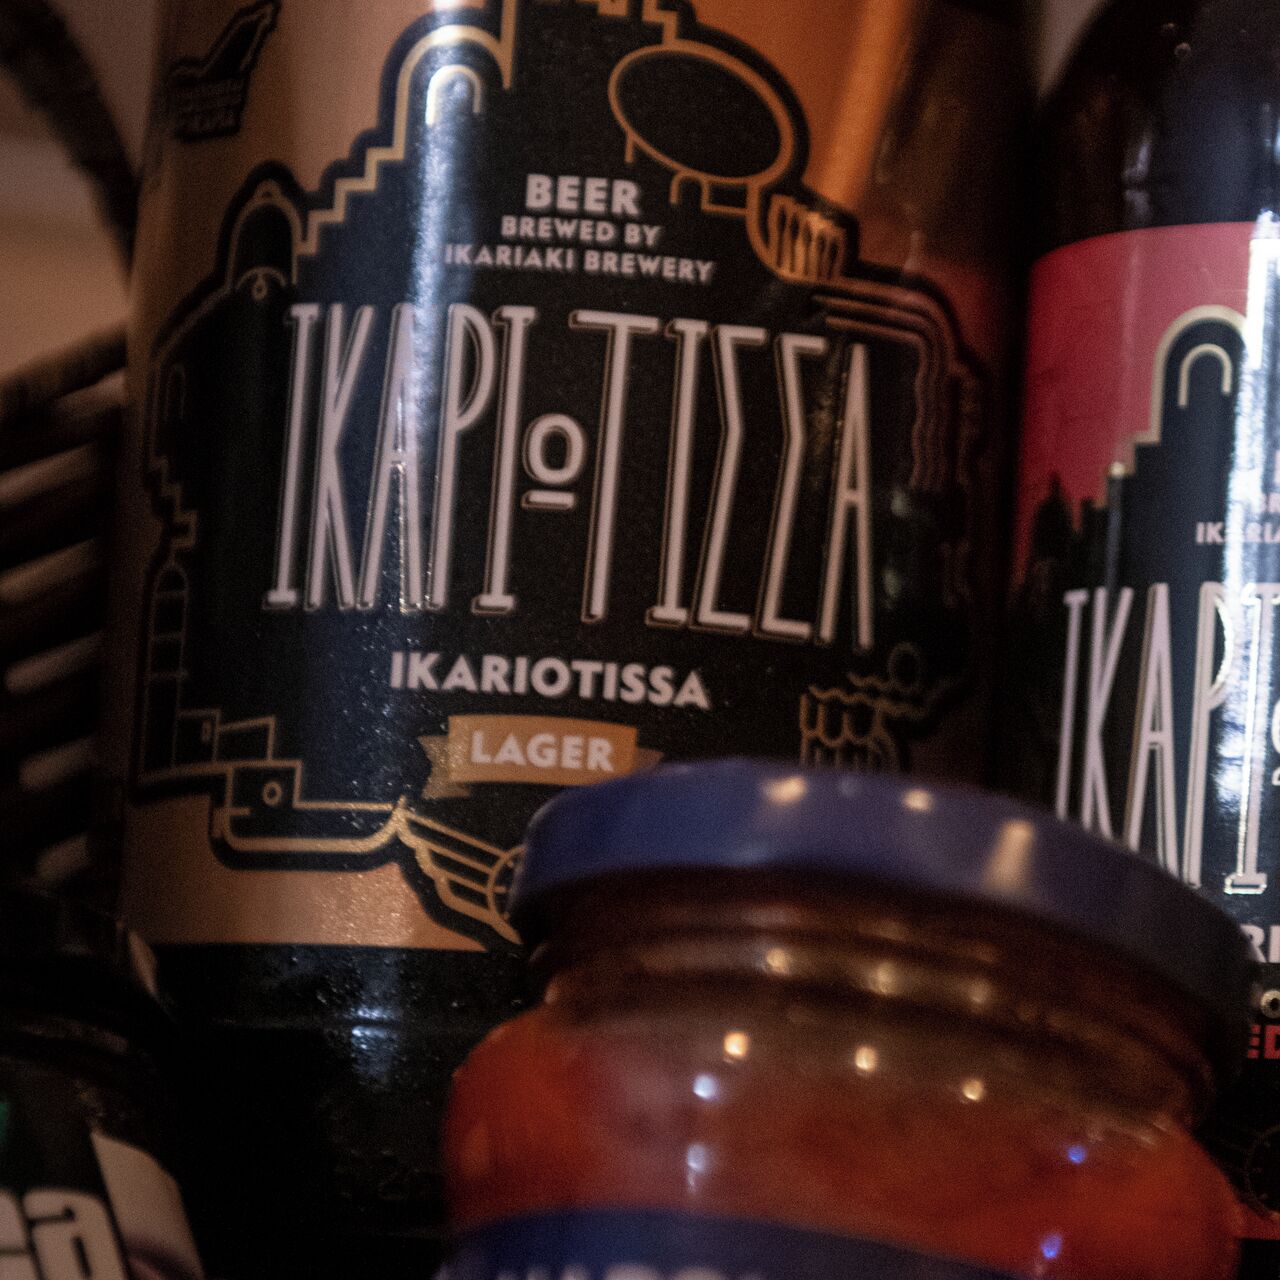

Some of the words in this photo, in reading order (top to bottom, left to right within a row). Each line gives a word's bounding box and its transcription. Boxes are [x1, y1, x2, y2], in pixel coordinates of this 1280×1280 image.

[525, 173, 641, 217] BEER
[501, 215, 617, 244] BREWED
[624, 223, 663, 248] BY
[444, 242, 575, 270] IKARIAKI
[584, 249, 718, 285] BREWERY
[389, 651, 712, 712] IKARIOTISSA
[470, 730, 615, 773] LAGER
